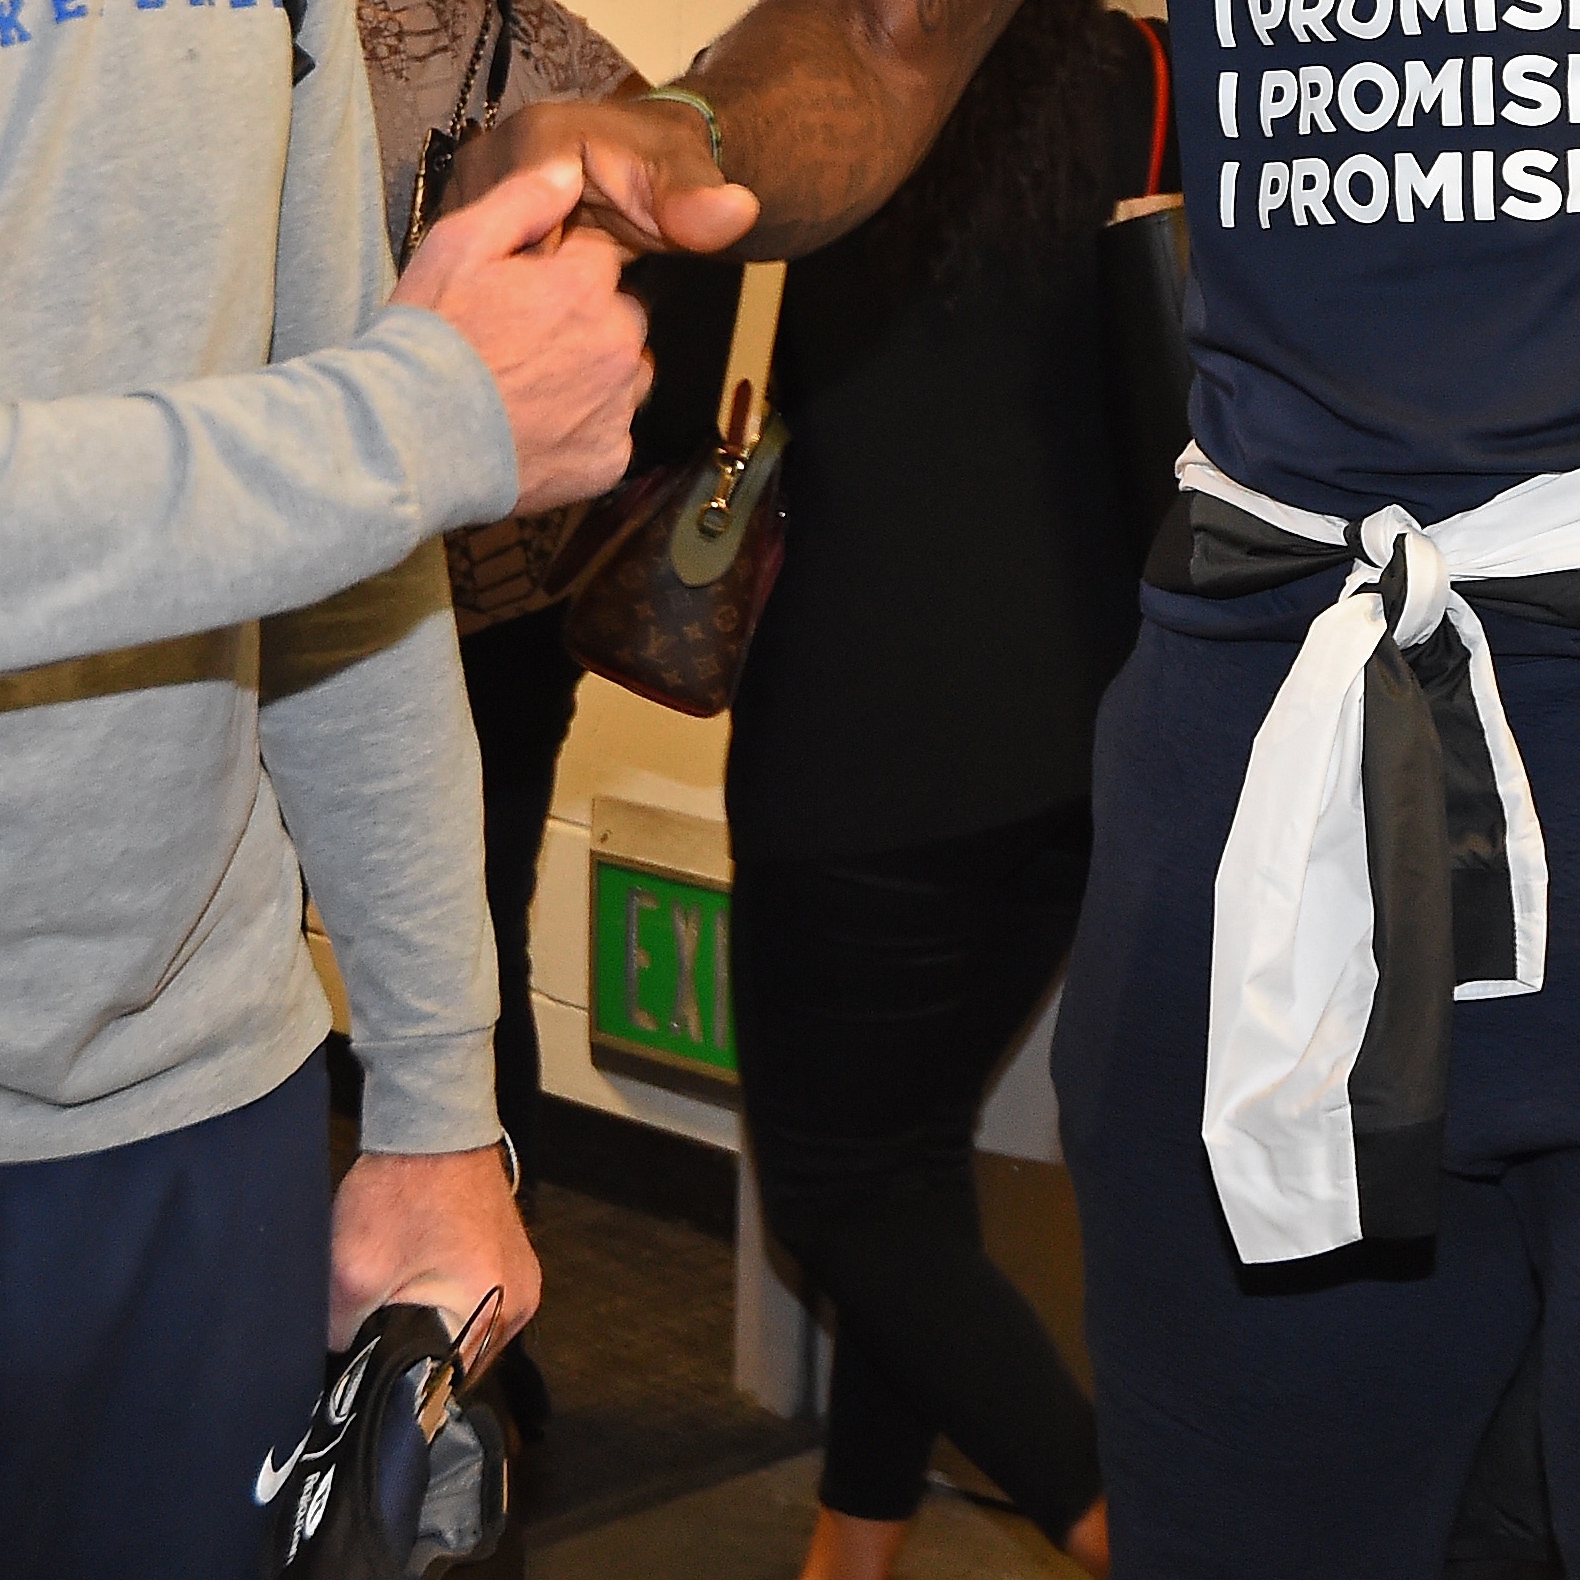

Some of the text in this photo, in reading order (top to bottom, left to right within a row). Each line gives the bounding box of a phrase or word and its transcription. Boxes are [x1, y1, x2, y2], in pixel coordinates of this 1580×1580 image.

[1219, 71, 1239, 138] I
[1219, 161, 1240, 229] I
[624, 886, 729, 1051] EXI
